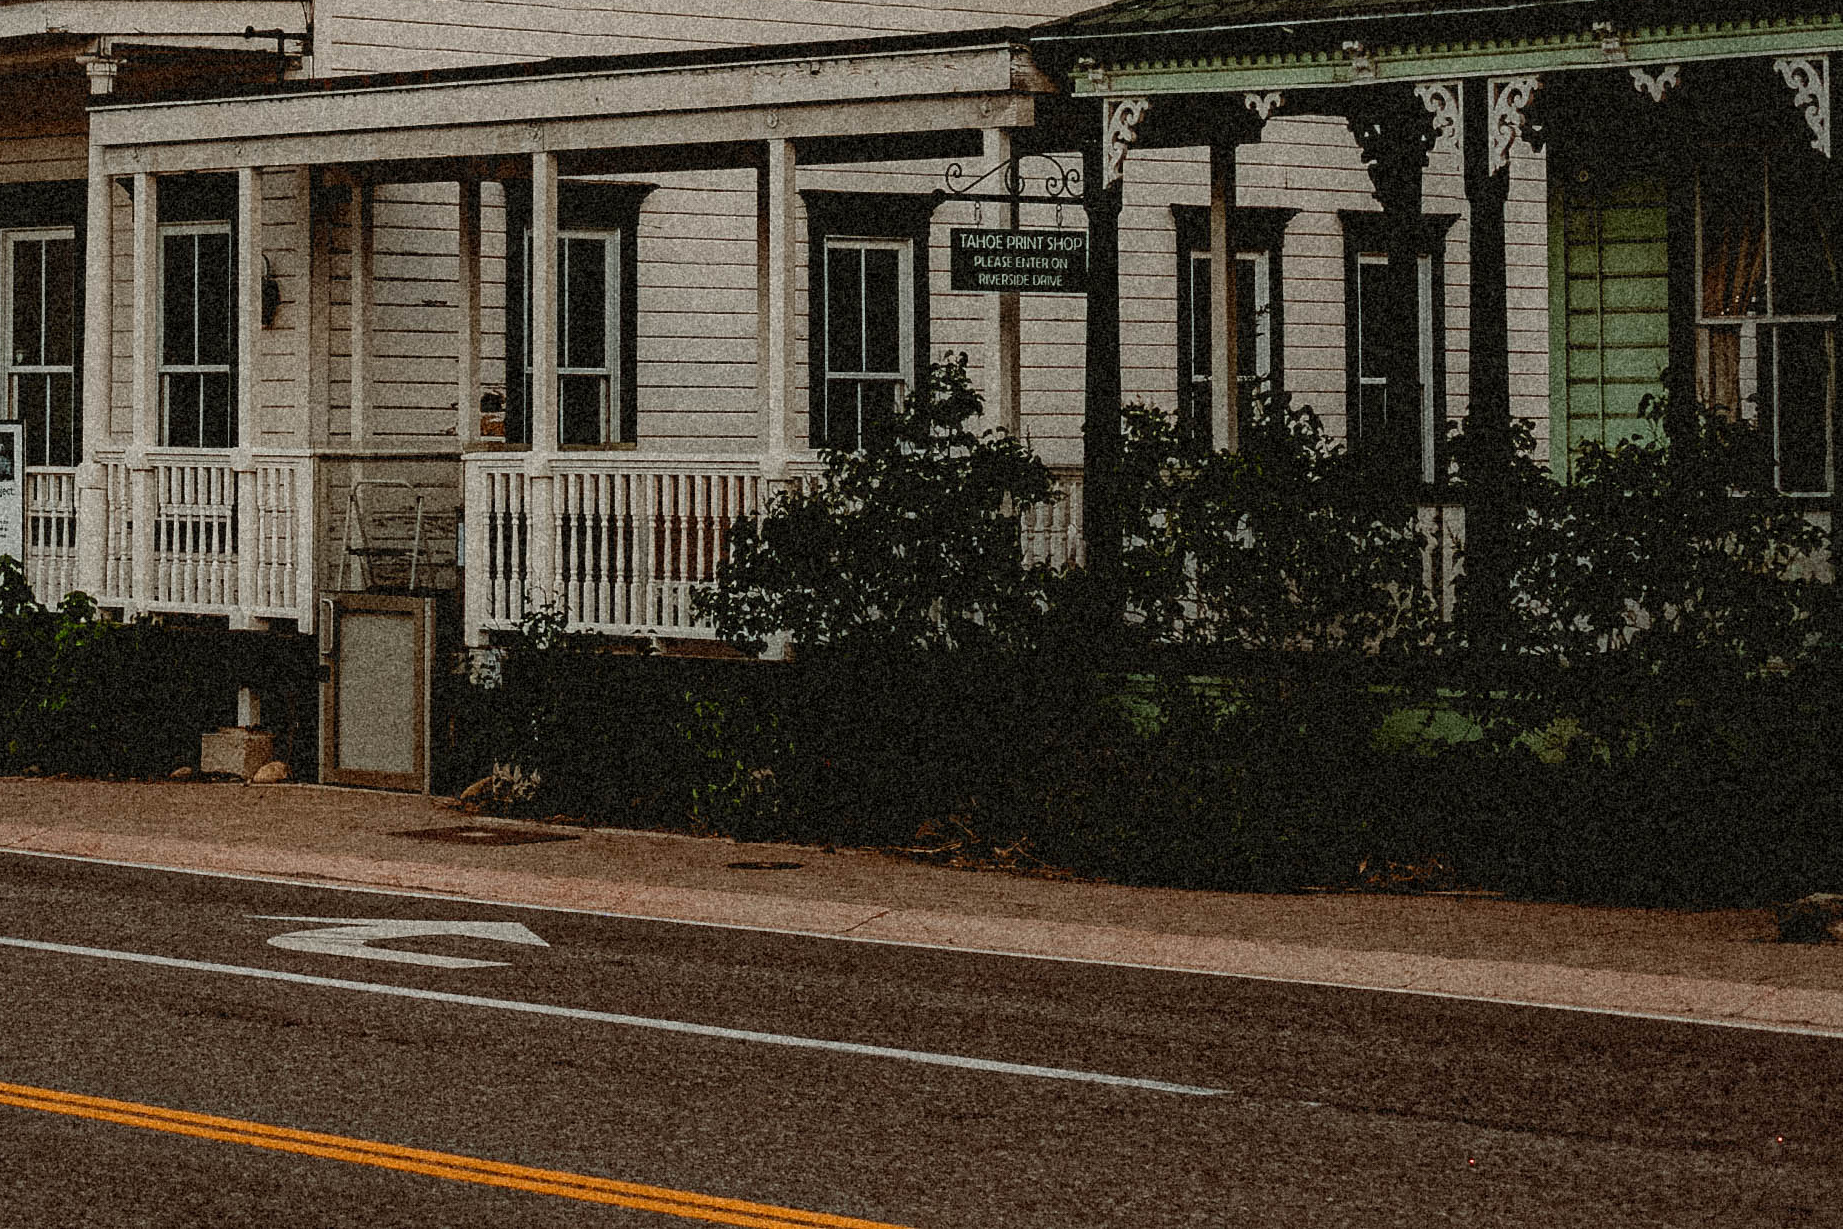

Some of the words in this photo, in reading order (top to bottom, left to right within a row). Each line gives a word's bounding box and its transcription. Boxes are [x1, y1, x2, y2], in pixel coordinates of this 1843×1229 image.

[960, 234, 1003, 250] TAHOE
[1006, 235, 1044, 251] PRINT
[1047, 237, 1083, 251] SHOP
[974, 256, 1013, 268] PLEASE
[1015, 257, 1049, 269] ENTER
[1051, 258, 1068, 270] ON
[979, 274, 1030, 286] RIVERSIDE
[1033, 274, 1063, 287] DRIVE
